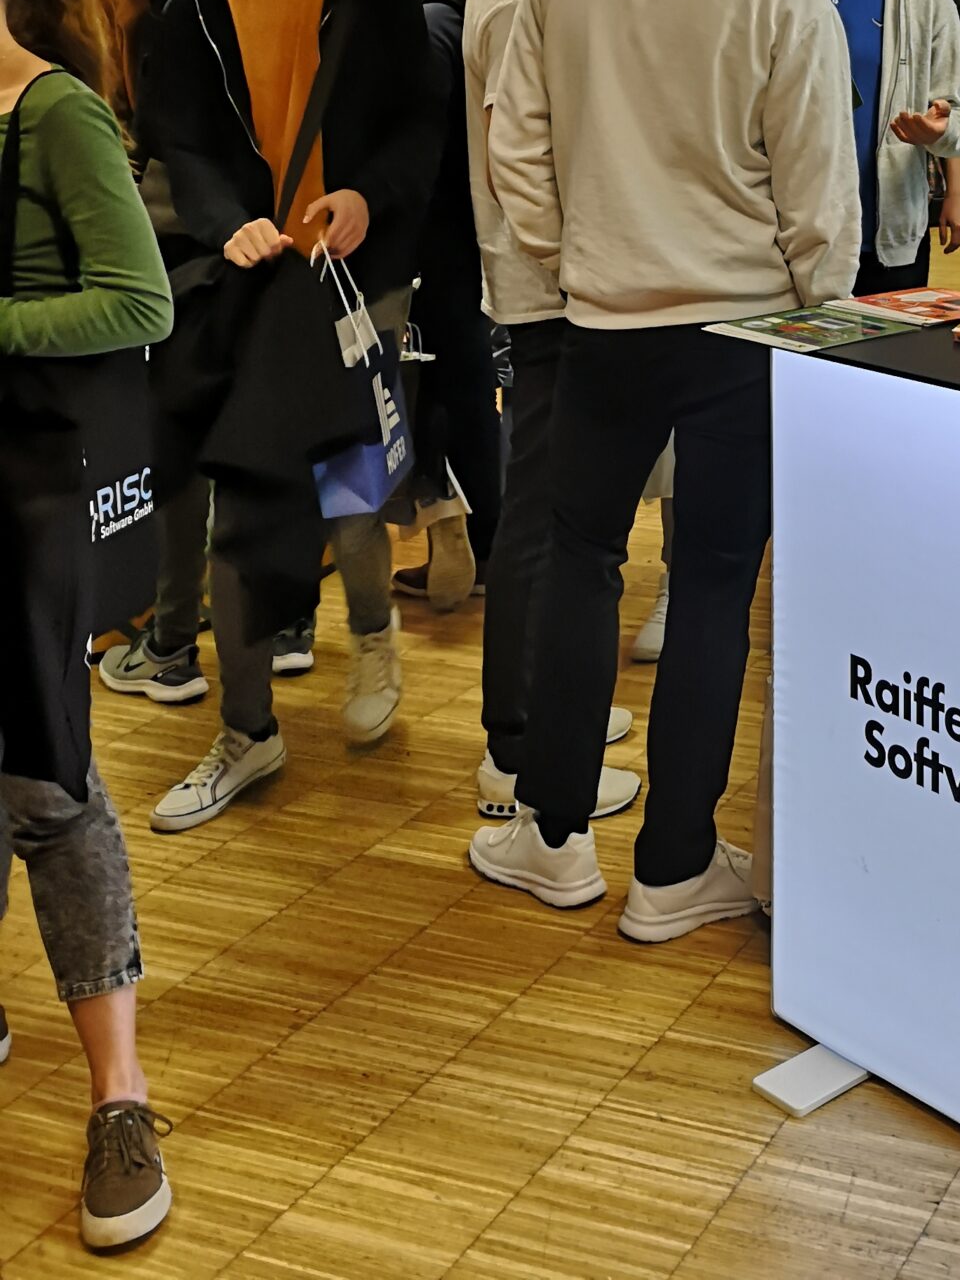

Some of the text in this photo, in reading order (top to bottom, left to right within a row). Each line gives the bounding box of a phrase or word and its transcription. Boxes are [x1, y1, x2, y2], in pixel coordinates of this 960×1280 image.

[386, 435, 407, 476] HOFER
[96, 466, 152, 524] RISC
[100, 500, 154, 540] Software GmbH
